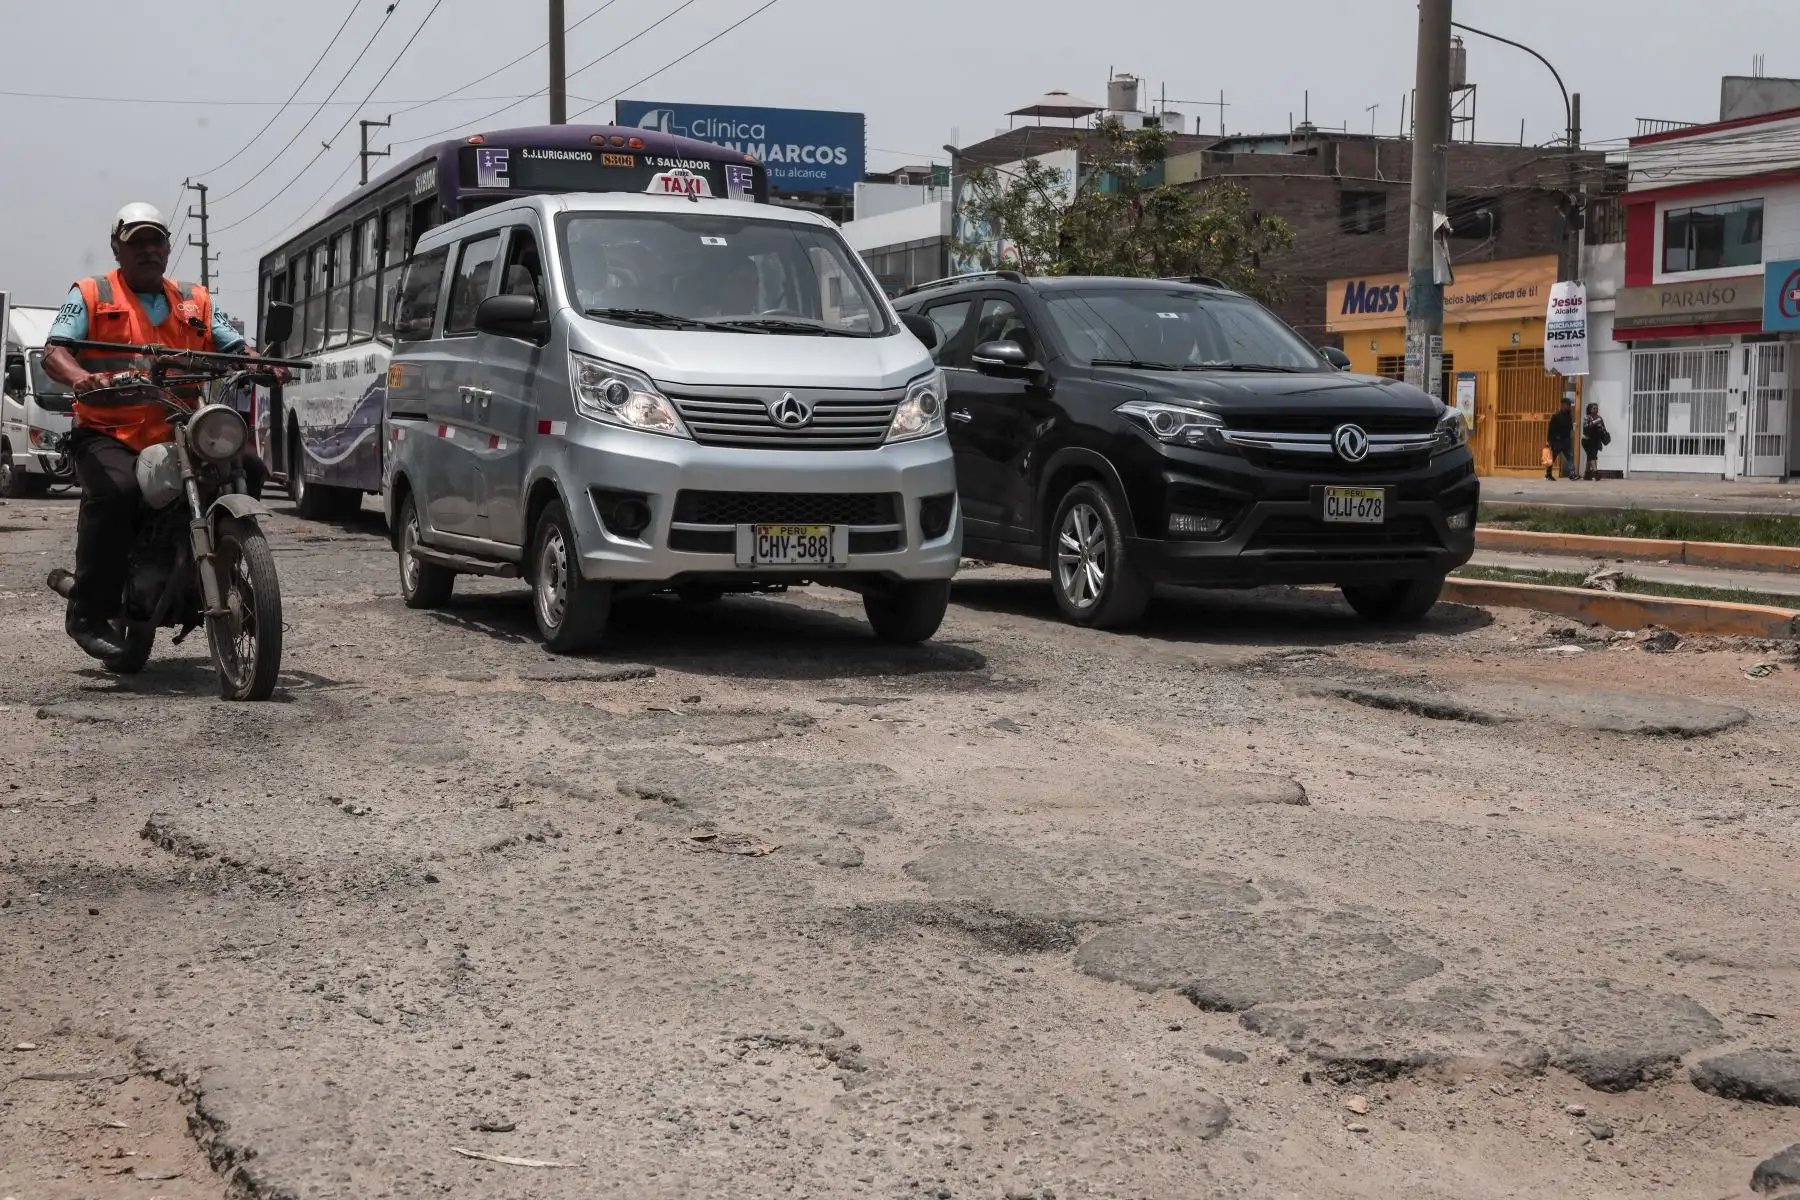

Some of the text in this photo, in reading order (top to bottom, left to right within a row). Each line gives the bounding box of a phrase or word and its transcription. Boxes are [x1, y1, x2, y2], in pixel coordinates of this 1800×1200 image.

[691, 118, 765, 140] Clínica
[522, 149, 593, 161] S.J.LURIGANCHO
[747, 142, 848, 165] MARCOS
[657, 158, 711, 171] SALVADOR
[775, 167, 786, 177] tu
[788, 167, 827, 178] alcance
[661, 176, 701, 195] TAXI
[1341, 280, 1400, 315] Mass
[1516, 287, 1527, 298] de
[1529, 285, 1538, 297] ti!
[1661, 283, 1736, 309] PARAÍSO
[1552, 294, 1583, 308] Jesús
[1547, 329, 1586, 341] PISTAS
[1327, 497, 1382, 517] CLU-678
[780, 526, 808, 535] PERU
[759, 535, 829, 558] CHY-588
